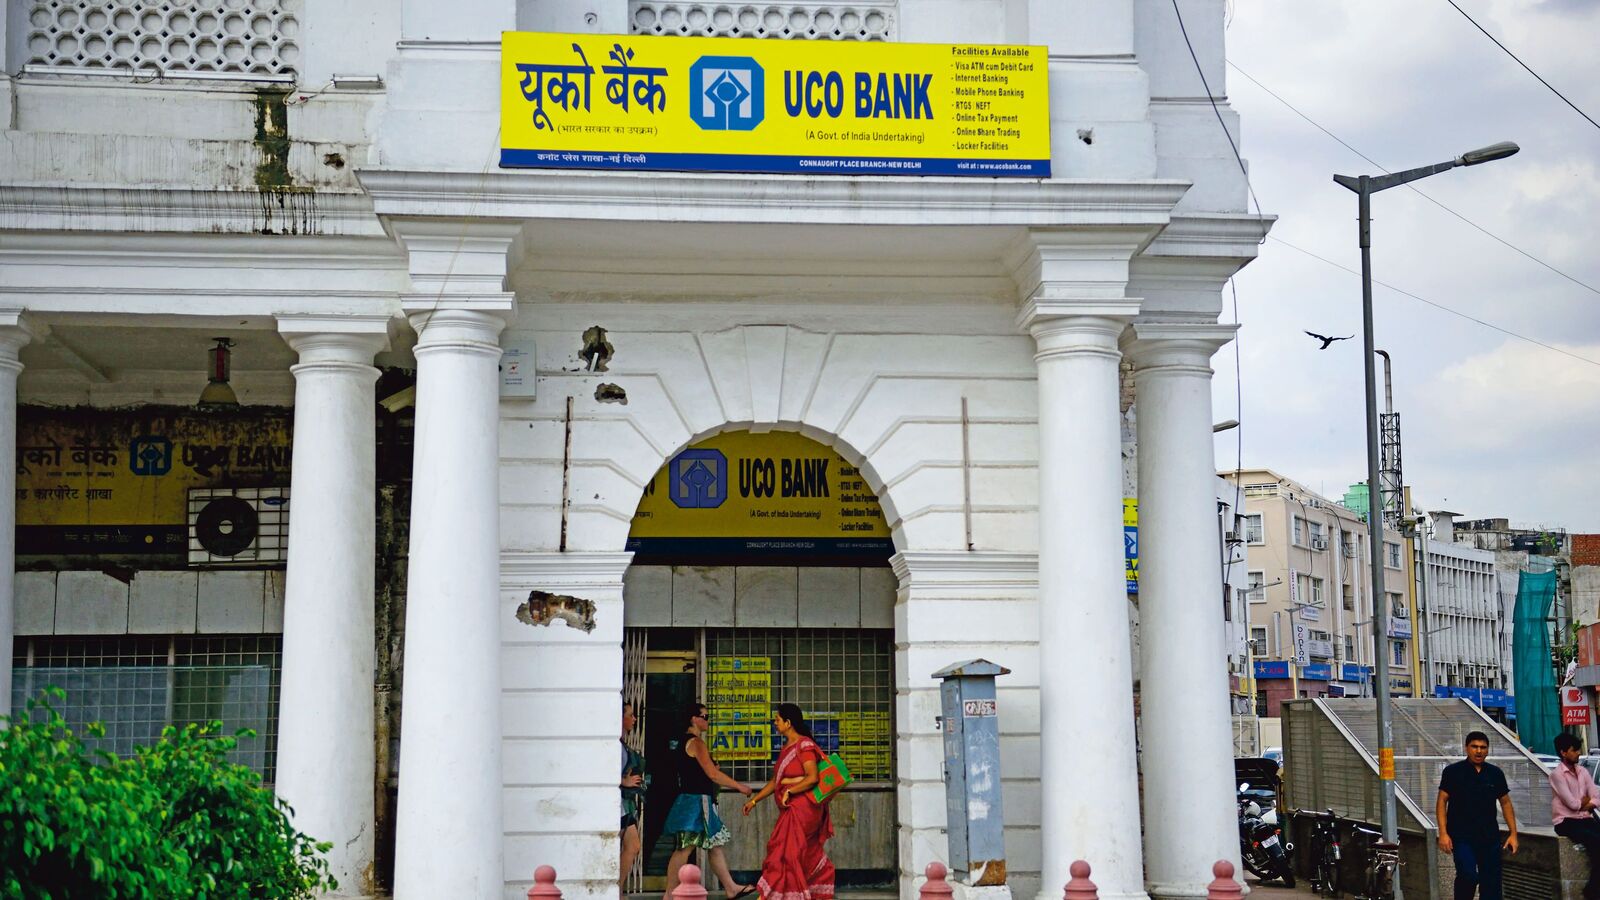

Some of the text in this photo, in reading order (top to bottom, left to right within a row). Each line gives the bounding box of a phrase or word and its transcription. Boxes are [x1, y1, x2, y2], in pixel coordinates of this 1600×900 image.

[952, 47, 1029, 57] Facilities Available
[955, 62, 1034, 71] Visa ATM cum Debit Card
[955, 74, 1008, 85] Internet Banking
[515, 43, 668, 132] यूको बैंक
[955, 87, 1024, 99] Mobile Phone Banking
[784, 70, 934, 120] UCO BANK
[956, 101, 991, 110] RTGS NEFT
[956, 113, 1018, 124] Online Tax Payment
[585, 125, 611, 134] सरकार
[613, 126, 625, 134] का
[956, 127, 1020, 139] Online Share Trading
[806, 129, 816, 140] (A
[841, 131, 849, 140] of
[852, 131, 870, 141] India
[873, 132, 925, 144] Undertaking)
[957, 142, 1009, 151] Locker Facilities
[799, 160, 838, 168] CONNAUGHT
[839, 160, 860, 168] PLACE
[903, 161, 922, 169] DELHI
[739, 458, 829, 498] UCO BANK
[1567, 709, 1586, 718] ATM
[713, 731, 763, 749] ATM
